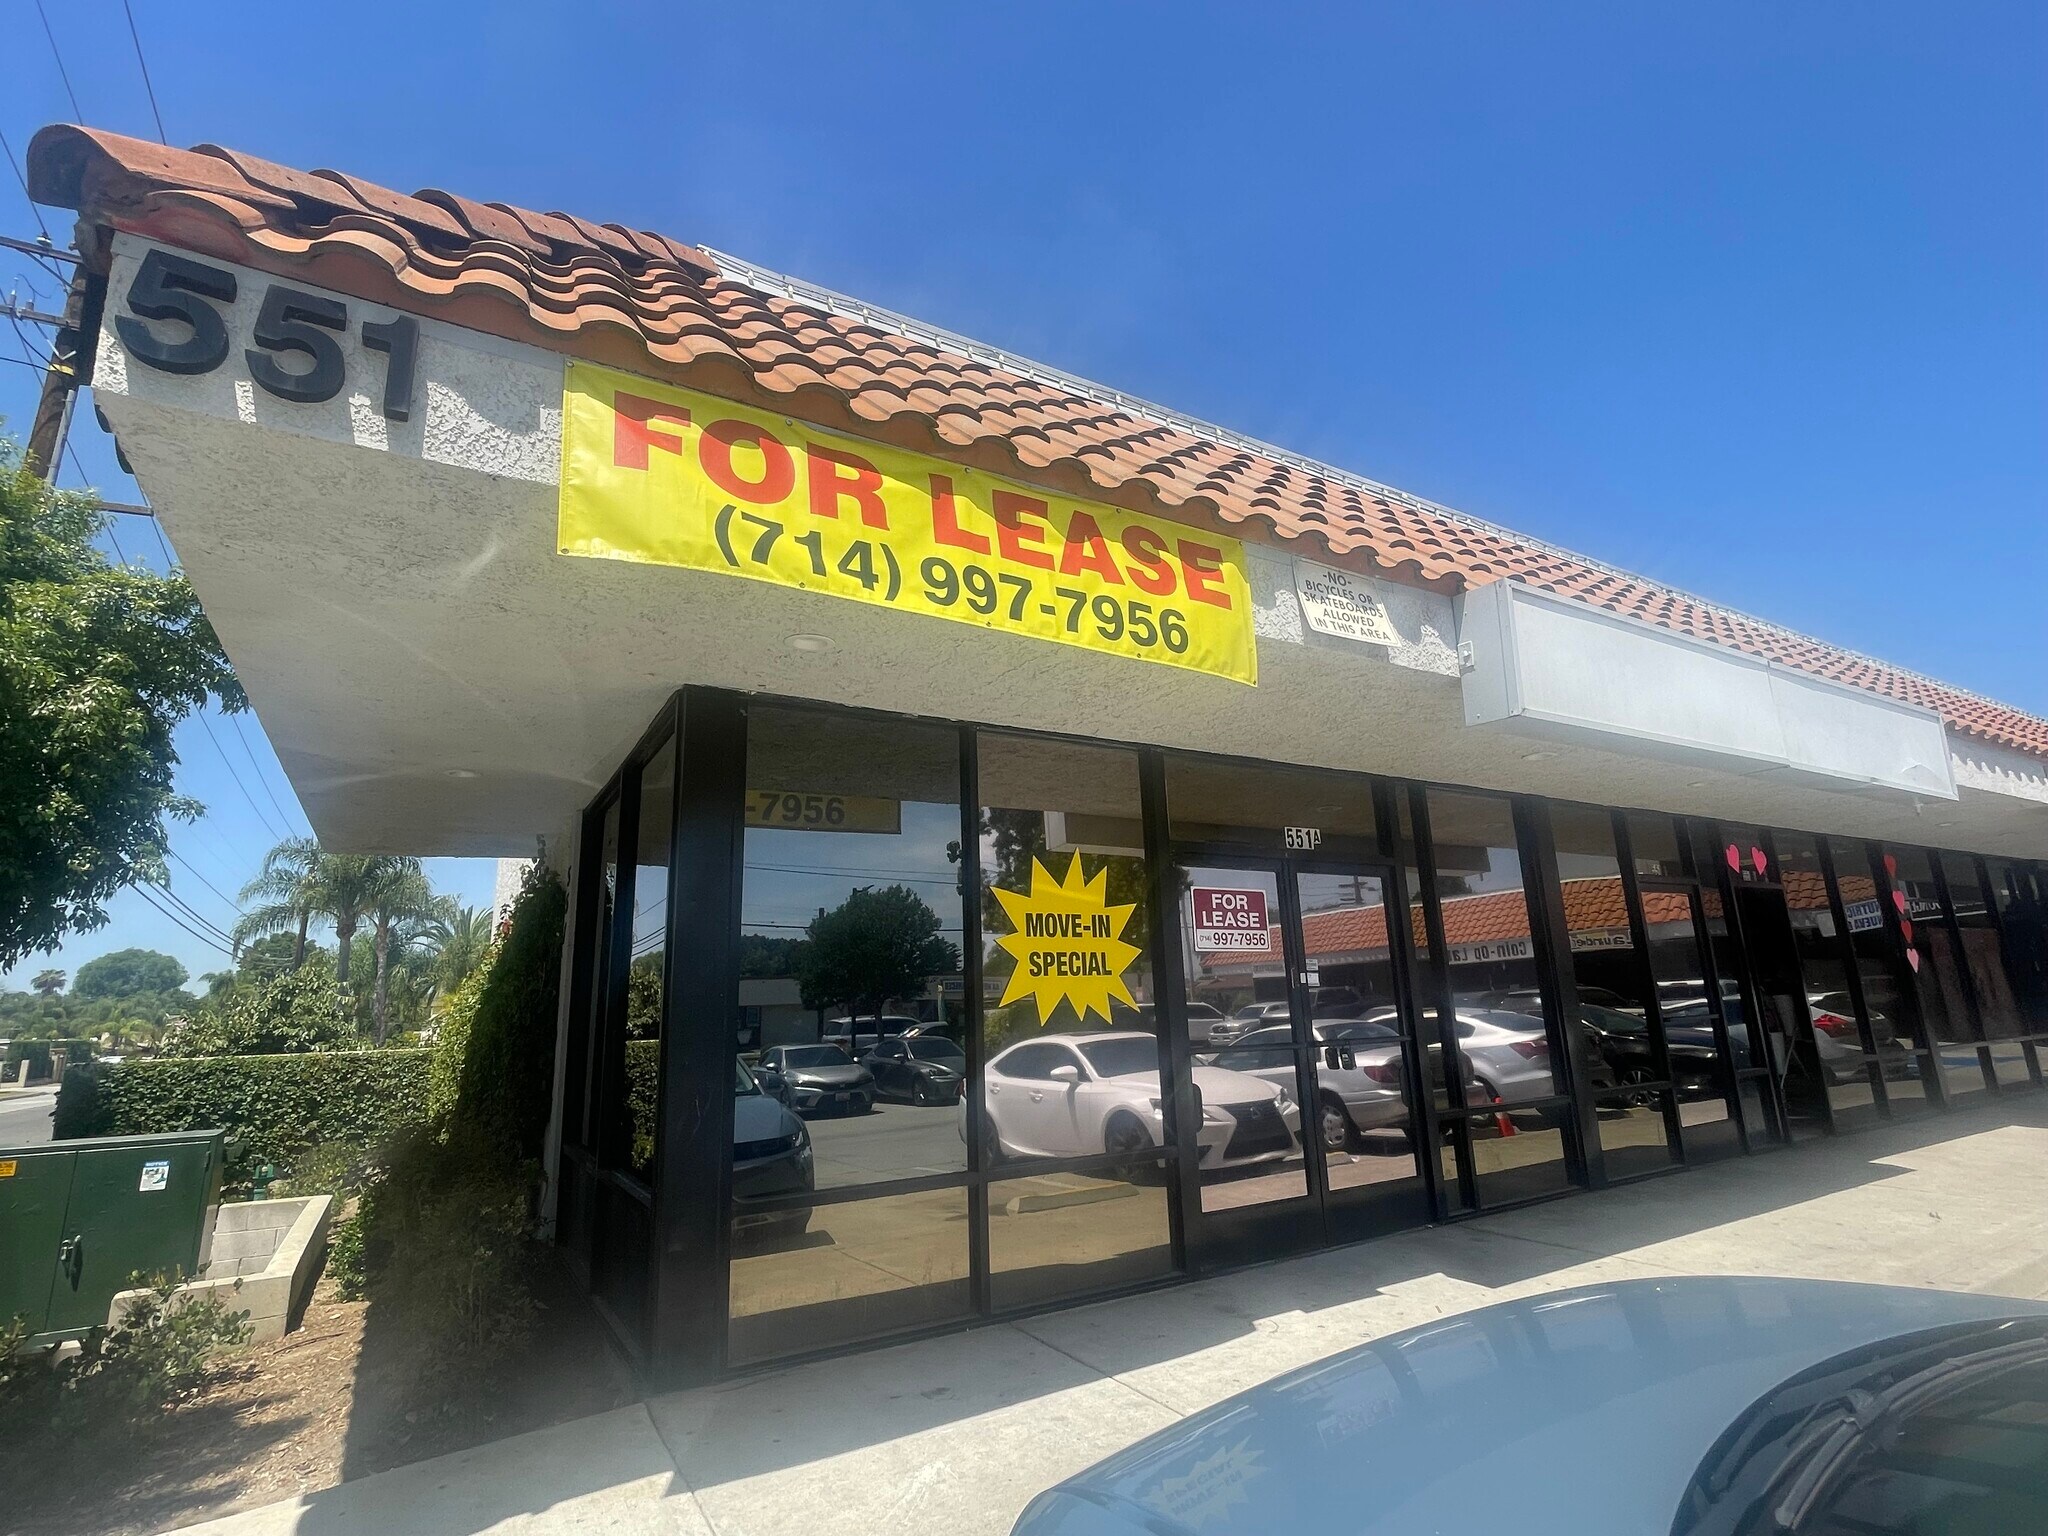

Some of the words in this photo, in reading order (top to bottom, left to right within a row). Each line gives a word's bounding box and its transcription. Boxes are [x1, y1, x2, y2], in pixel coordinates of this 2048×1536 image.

[115, 248, 420, 421] 551
[613, 390, 890, 531] FOR
[930, 474, 1232, 609] LEASE
[714, 503, 901, 602] (714)
[919, 556, 1189, 654] 997-7956
[1304, 591, 1384, 618] SKATEBOARDS
[1305, 580, 1355, 601] BICYCLES
[1358, 593, 1374, 606] OR
[1314, 617, 1329, 628] IN
[1330, 621, 1356, 634] THIS
[1360, 627, 1392, 641] AREA
[1323, 608, 1375, 627] ALLOWED
[1286, 828, 1320, 849] 551A
[1211, 893, 1249, 910] FOR
[1025, 912, 1111, 938] MOVE-IN
[1202, 911, 1261, 928] LEASE
[1213, 932, 1266, 946] 997-7956
[1029, 951, 1112, 977] SPECIAL
